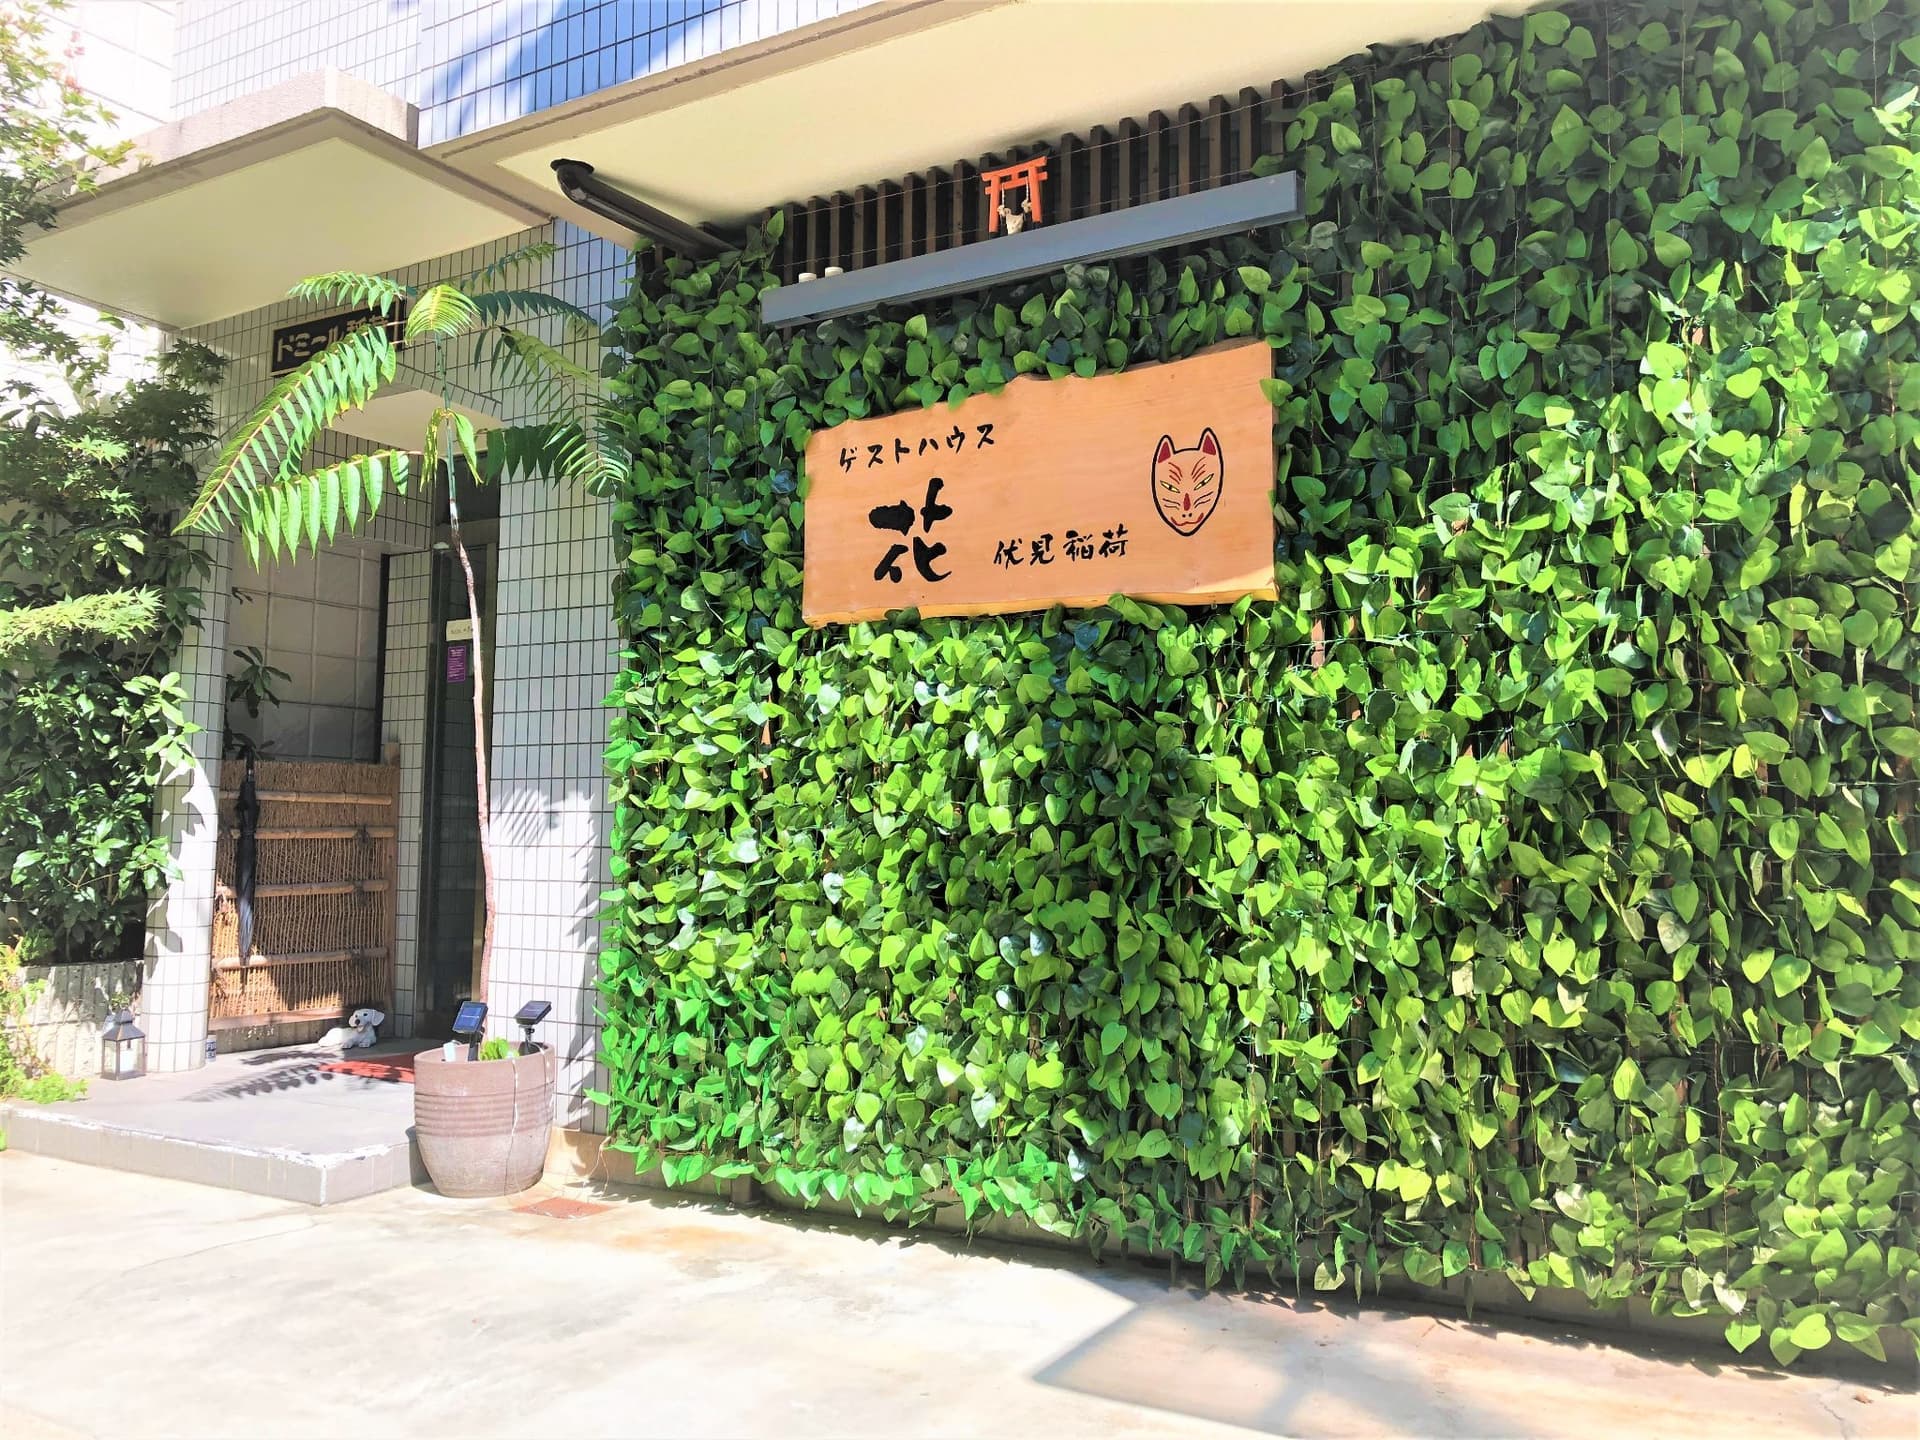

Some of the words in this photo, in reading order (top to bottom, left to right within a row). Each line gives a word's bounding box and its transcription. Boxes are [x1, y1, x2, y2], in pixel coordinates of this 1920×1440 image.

[838, 424, 995, 472] ゲストハウス
[868, 477, 953, 584] 花
[993, 523, 1129, 570] 伏見稲荷
